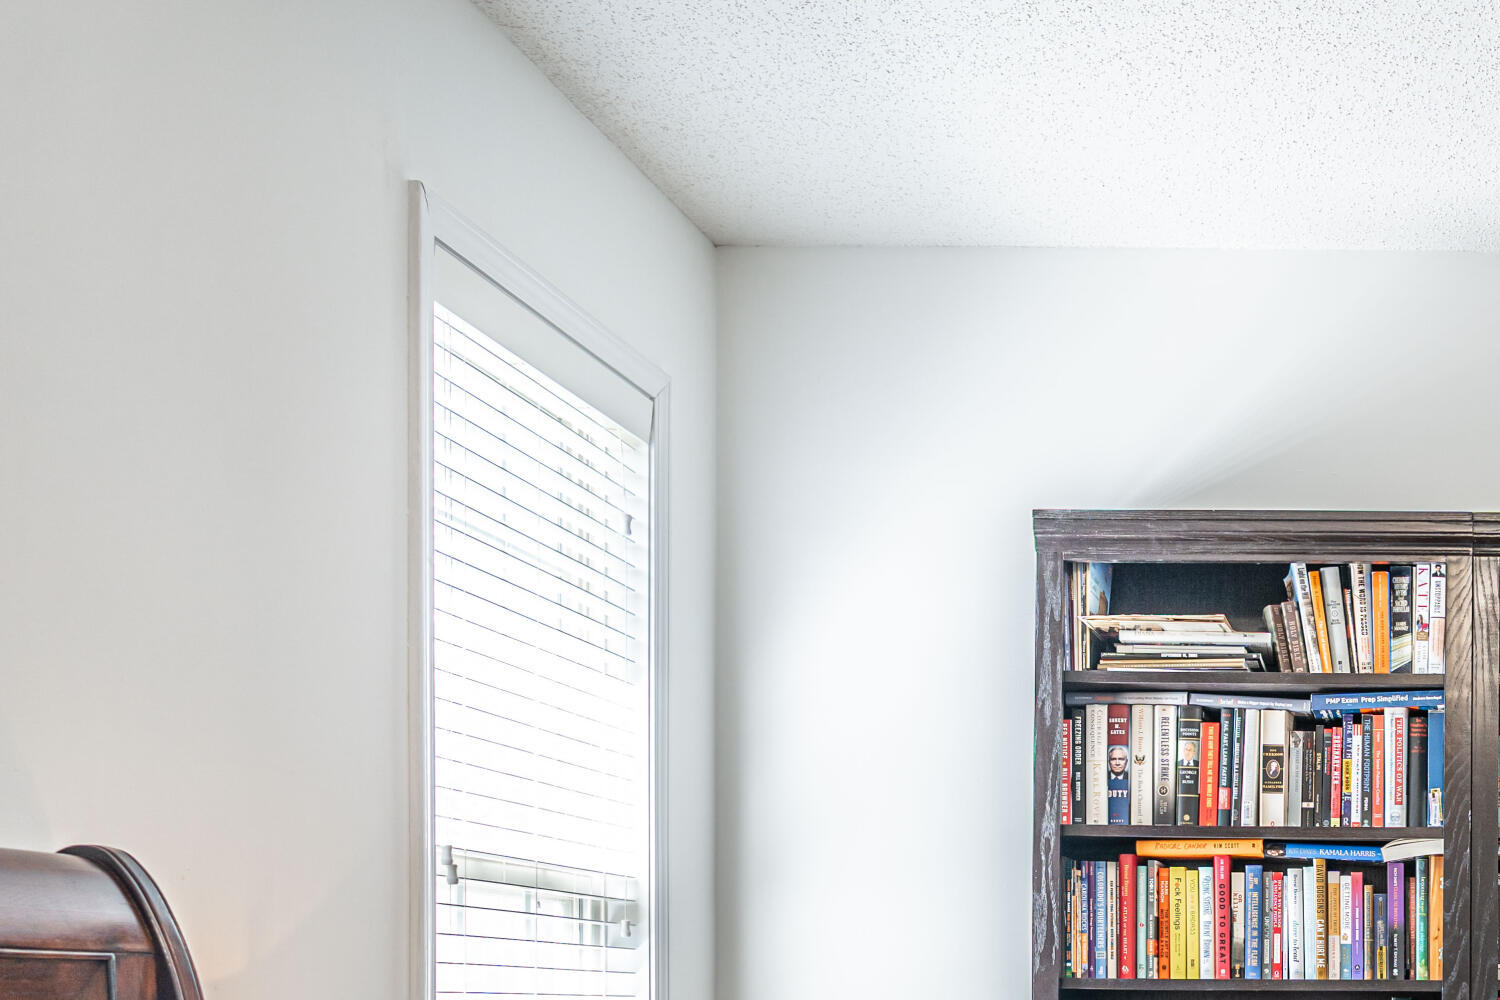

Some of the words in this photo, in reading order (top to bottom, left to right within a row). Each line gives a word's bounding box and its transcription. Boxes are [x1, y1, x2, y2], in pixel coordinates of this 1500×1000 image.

[1279, 643, 1288, 662] BIBLE
[1292, 640, 1301, 661] BIBLE
[1161, 717, 1169, 756] RELENTLESS
[1161, 759, 1169, 782] STRIKE
[1397, 773, 1402, 783] OF
[1173, 899, 1181, 930] Feelings
[1220, 916, 1226, 927] TO
[1317, 920, 1325, 937] CAN'T
[1317, 940, 1325, 957] HURT
[1317, 959, 1325, 968] ME
